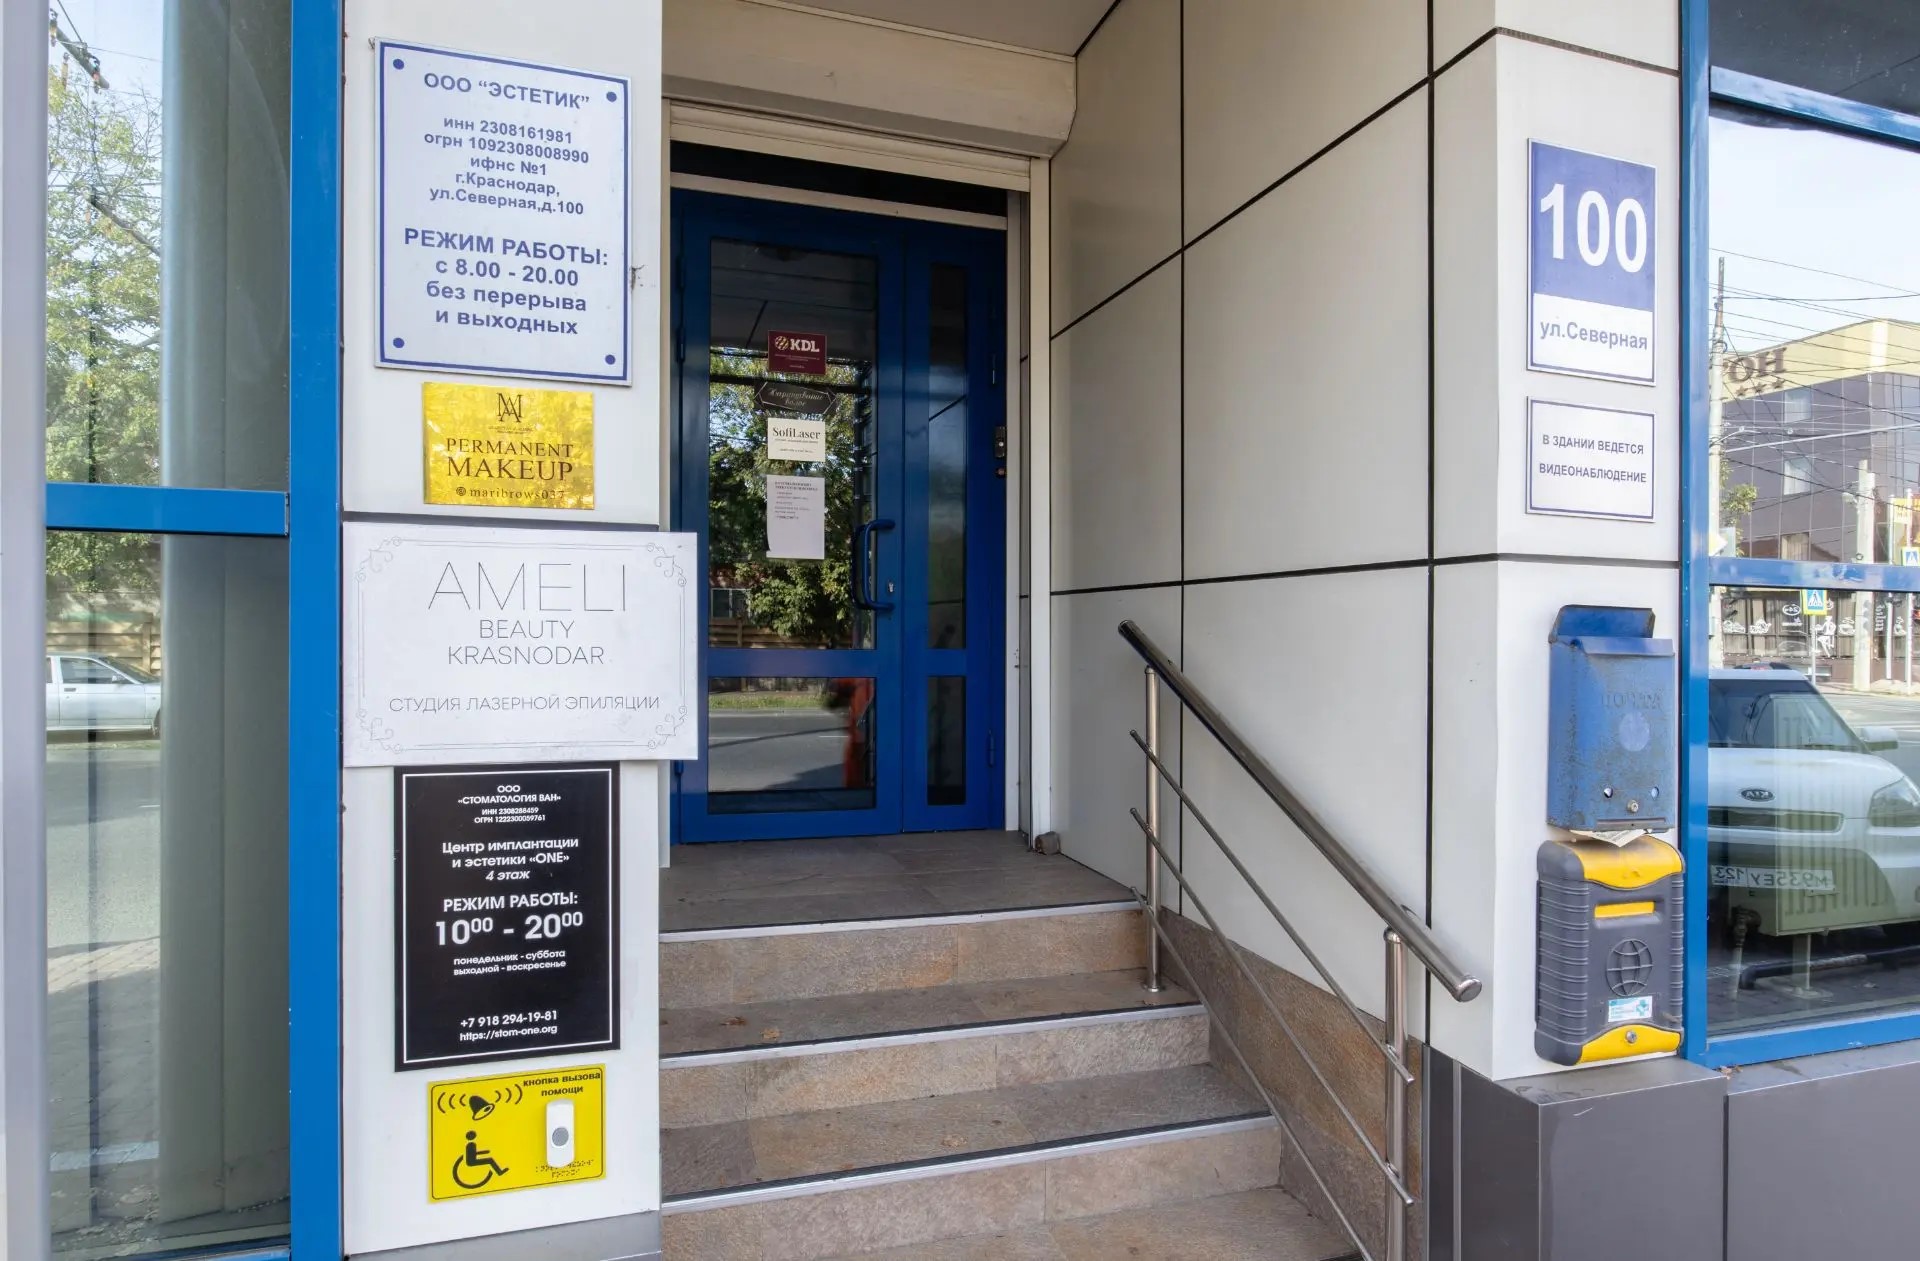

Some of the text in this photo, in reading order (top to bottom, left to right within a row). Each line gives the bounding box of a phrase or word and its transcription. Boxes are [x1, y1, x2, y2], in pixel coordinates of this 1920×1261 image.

[424, 73, 472, 93] ООО
[443, 117, 572, 144] инн 2308161981
[424, 133, 589, 164] огрн 1092308008990
[470, 156, 547, 176] ифнс №1
[455, 173, 561, 198] г.Краснодар,
[1540, 183, 1647, 273] 100
[404, 228, 608, 266] РЕЖИМ РАБОТЫ:
[436, 261, 448, 274] с
[455, 259, 501, 278] 8.00
[522, 266, 579, 286] 20.00
[426, 280, 588, 311] без перерыва
[435, 311, 578, 334] и выходных
[790, 338, 820, 352] KDL
[1540, 320, 1647, 350] ул.Северная
[772, 427, 820, 440] SofiLaser
[446, 438, 573, 457] PERMANENT
[1542, 434, 1644, 455] В ЗДАНИИ ВЕДЕТСЯ
[448, 456, 573, 481] MAKEUP
[1539, 463, 1647, 483] ВИДЕОНАБЛЮДЕНИЕ
[428, 561, 625, 612] AMELI
[480, 619, 575, 639] BEAUTY
[448, 646, 604, 665] KRASNODAR
[389, 694, 660, 714] СТУДИЯ ЛАЗЕРНОЙ ЭПИЛЯЦИИ
[458, 794, 561, 805] «СТОМАТОЛОГИЯ ВАН»
[474, 816, 493, 824] ОГРН
[442, 839, 578, 855] Центр имплантации
[452, 852, 569, 867] и эстетики «ONE»
[485, 870, 530, 880] 4 этаж
[443, 892, 578, 912] РЕЖИМ РАБОТЫ:
[453, 953, 518, 966] понедельник
[525, 949, 566, 961] суббота
[453, 964, 499, 976] выходной
[507, 960, 566, 971] воскресенье
[460, 1010, 557, 1028] +7 918 294-19-81
[459, 1025, 558, 1041] https://stom-one.org
[523, 1072, 601, 1087] кнопка вызова
[541, 1086, 584, 1097] помощи
